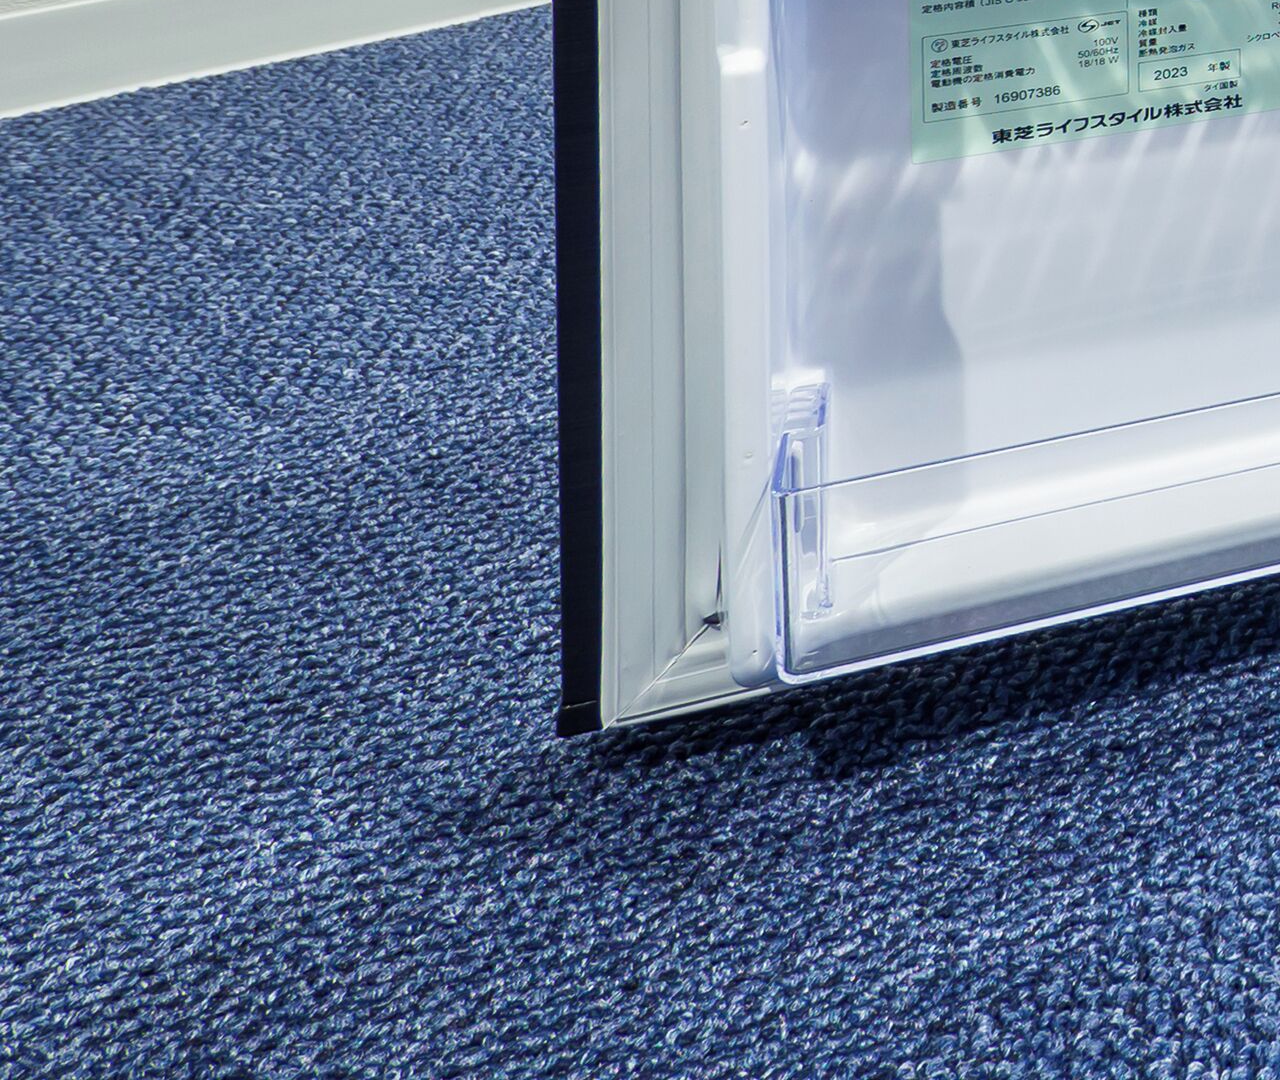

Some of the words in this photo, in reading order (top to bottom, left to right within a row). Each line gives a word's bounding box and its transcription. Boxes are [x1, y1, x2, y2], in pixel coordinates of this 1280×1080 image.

[1137, 7, 1158, 18] 種類
[1100, 18, 1121, 27] JET
[950, 24, 1069, 49] 東芝ライフスタイル株式会社
[1137, 36, 1157, 48] 質量
[1077, 44, 1119, 59] 50/60Hz
[929, 54, 972, 69] 定格電圧
[1206, 59, 1231, 73] 年製
[929, 63, 983, 79] 定格周波数
[929, 65, 1036, 89] 電動機の定格消費電力
[1153, 65, 1188, 81] 2023
[1202, 79, 1238, 93] タイ国製
[930, 96, 982, 114] 製造番号
[993, 83, 1061, 105] 16907386
[991, 91, 1243, 145] 東芝ライフスタイル株式会社
